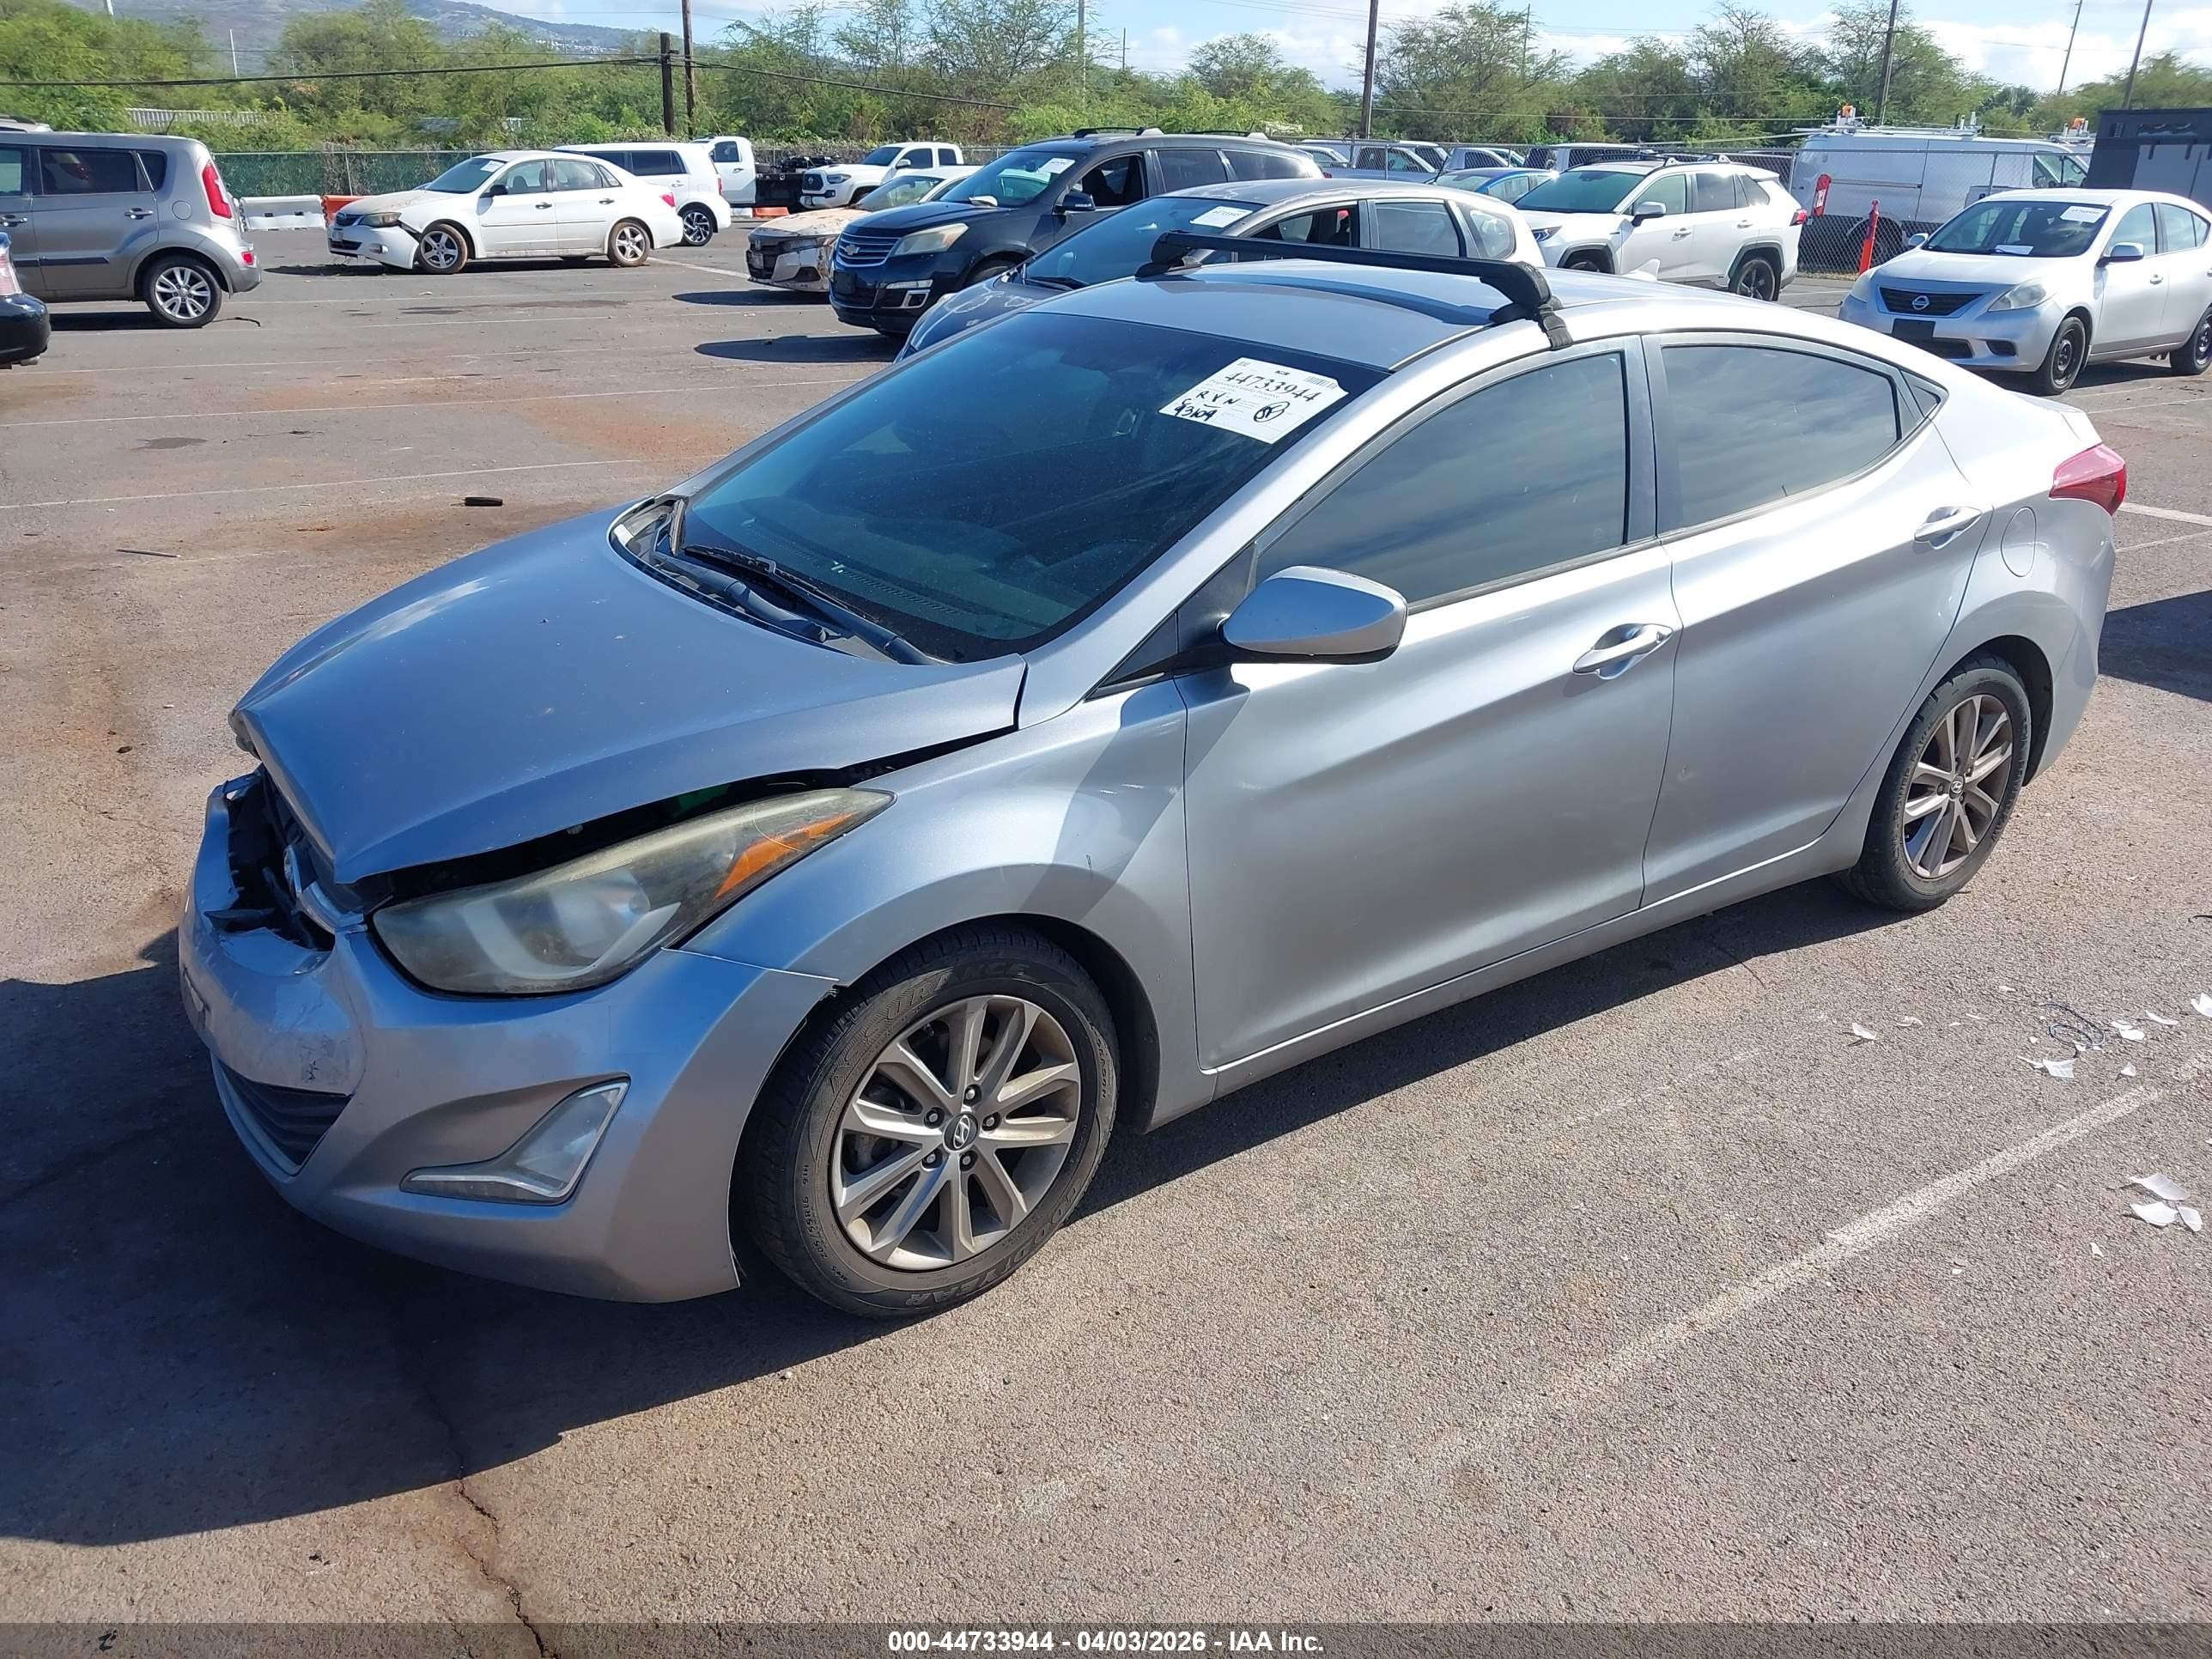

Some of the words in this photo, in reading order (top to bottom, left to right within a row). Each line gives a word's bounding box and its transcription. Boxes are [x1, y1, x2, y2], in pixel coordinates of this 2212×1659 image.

[1224, 372, 1322, 403] 44733944
[802, 1196, 828, 1259] 205/55R16
[904, 1187, 1077, 1307] GOODYEAR
